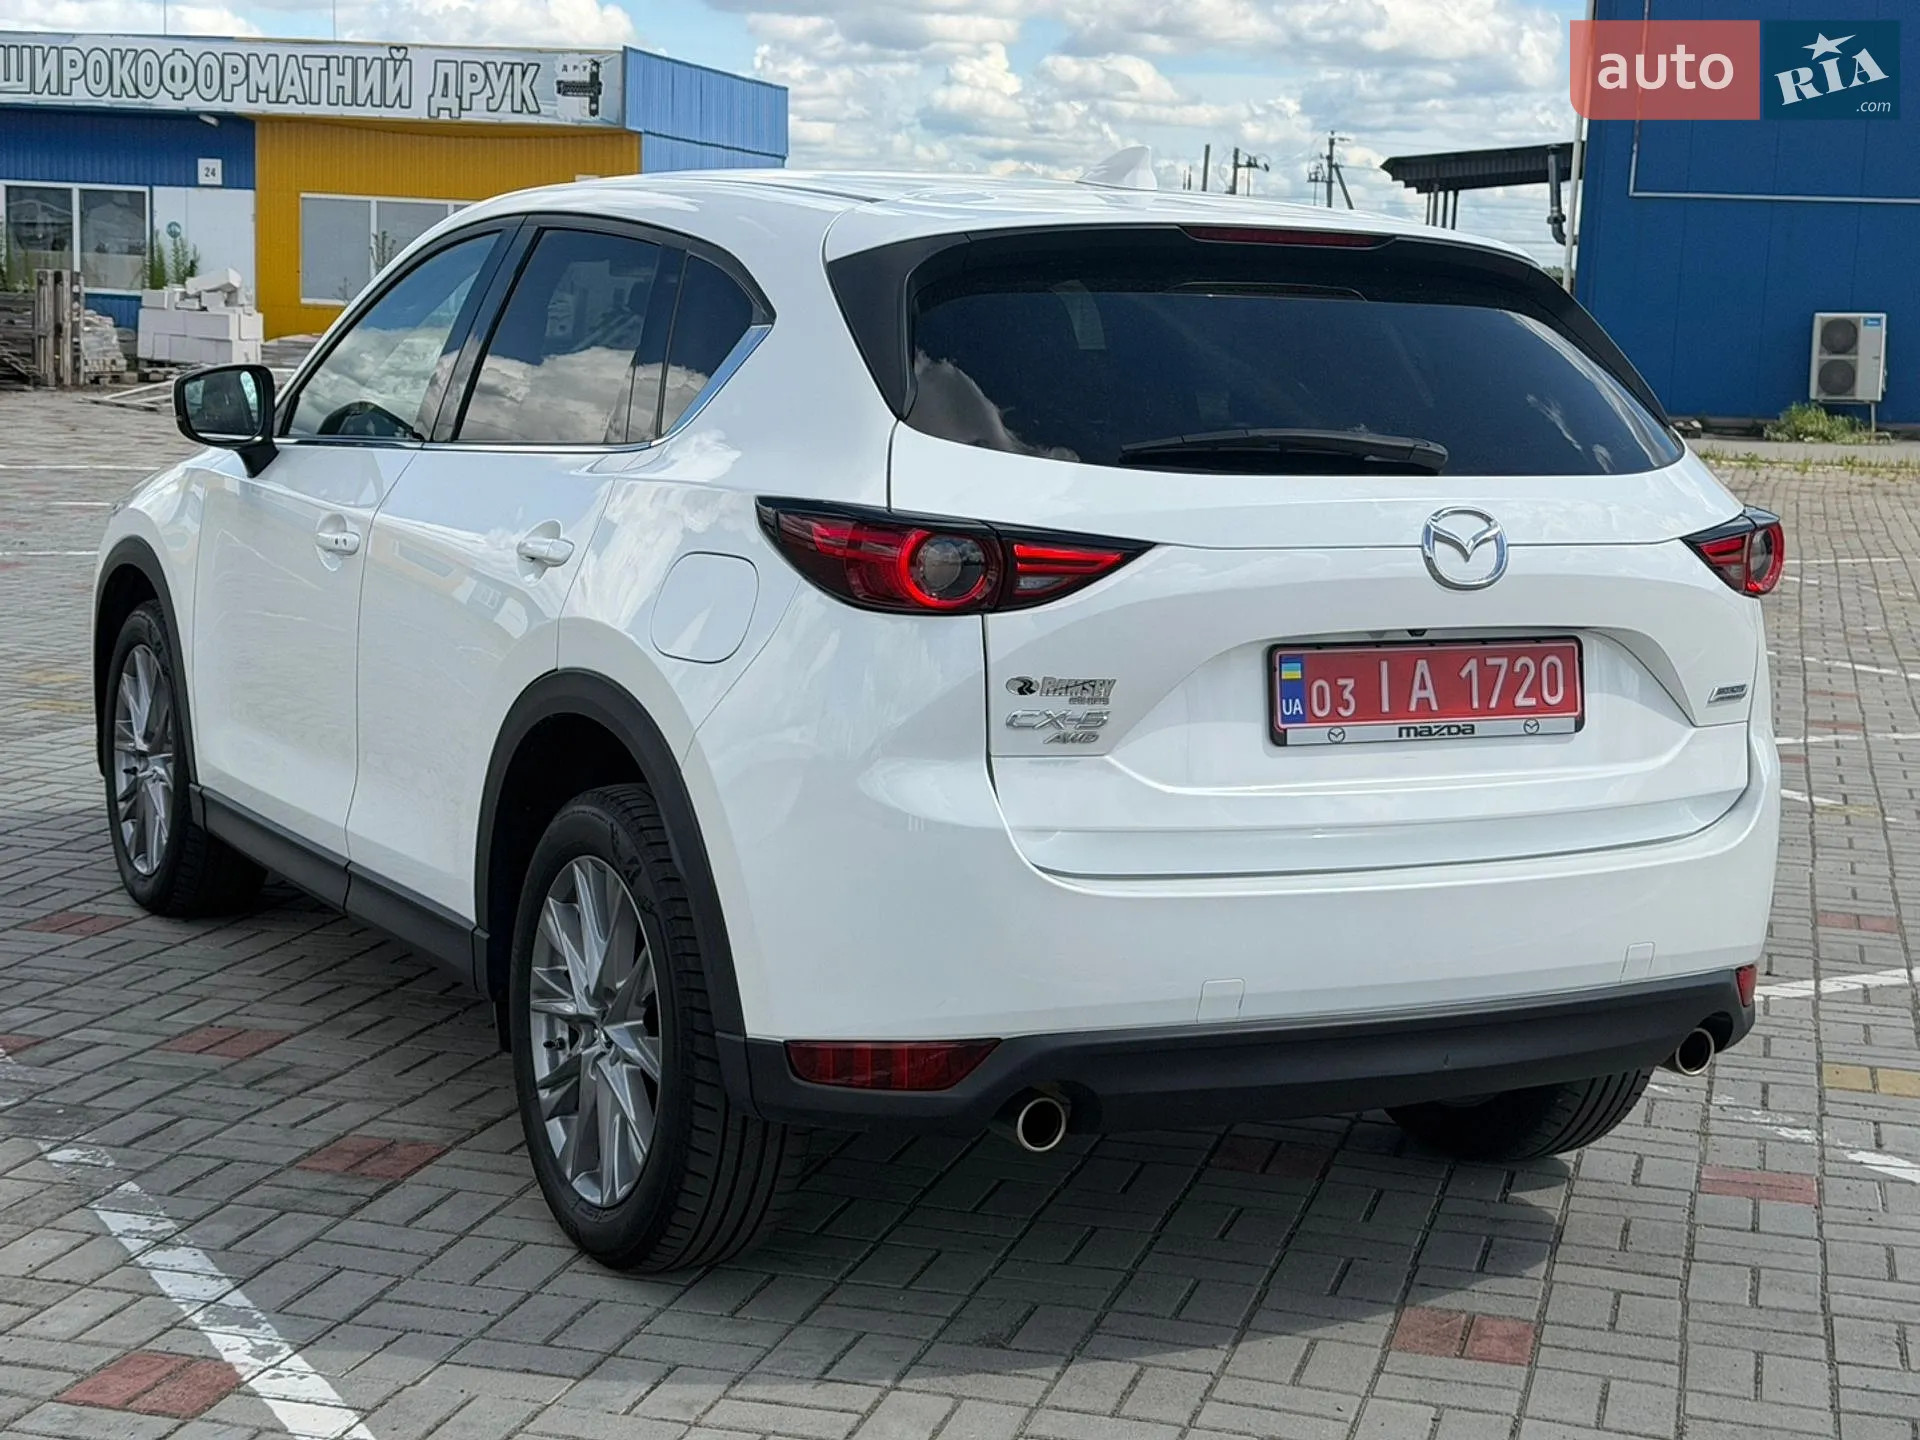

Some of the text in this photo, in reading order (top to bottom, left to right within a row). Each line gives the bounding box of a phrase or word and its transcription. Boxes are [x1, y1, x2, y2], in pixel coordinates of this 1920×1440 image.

[0, 45, 541, 118] ШИРОКОФОРМАТНИЙ ДРУК
[204, 167, 216, 177] 24
[1310, 678, 1356, 718] 03
[1459, 655, 1565, 710] 1720
[1282, 698, 1303, 716] UA
[1006, 709, 1112, 730] CX-5
